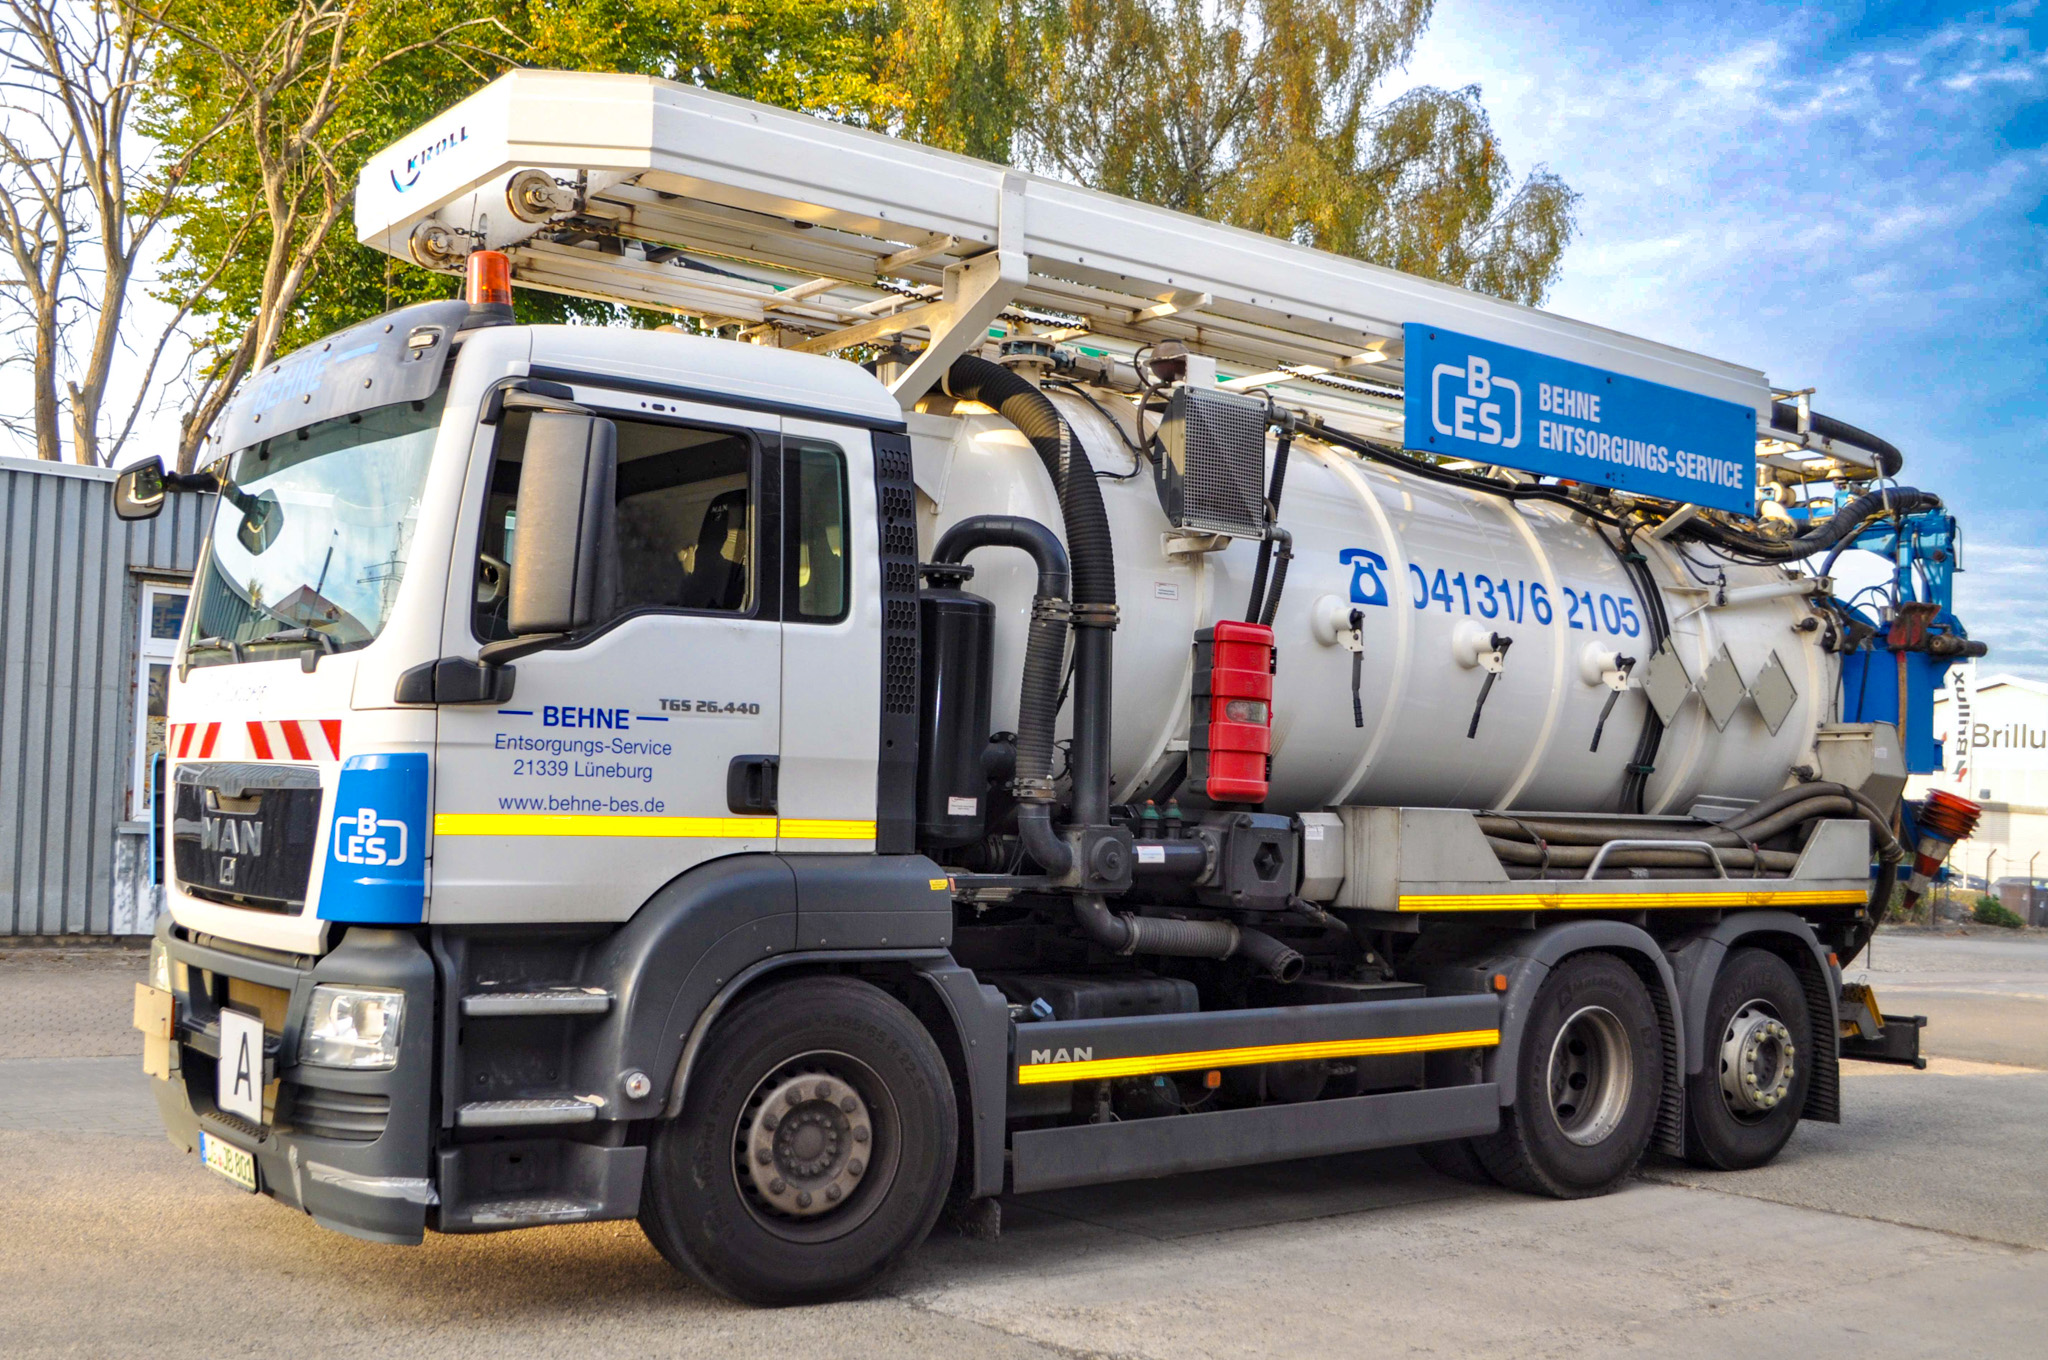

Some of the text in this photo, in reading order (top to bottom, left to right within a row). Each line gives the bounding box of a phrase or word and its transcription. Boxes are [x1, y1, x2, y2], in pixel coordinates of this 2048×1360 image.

[407, 126, 469, 174] KROLL
[252, 350, 332, 415] BEHNE
[1539, 383, 1600, 423] BEHNE
[1539, 421, 1743, 489] ENTSORGUNGS-SERVICE
[542, 705, 630, 730] BEHNE
[658, 698, 760, 715] TGS 26.440
[1952, 671, 1970, 756] Brillux
[495, 733, 673, 757] Entsorgungs-Service
[513, 759, 653, 783] 21339 Lüneburg
[498, 795, 665, 813] www.behne-bes.de
[201, 817, 263, 857] MAN
[234, 1032, 252, 1102] A
[1031, 1046, 1093, 1065] MAN
